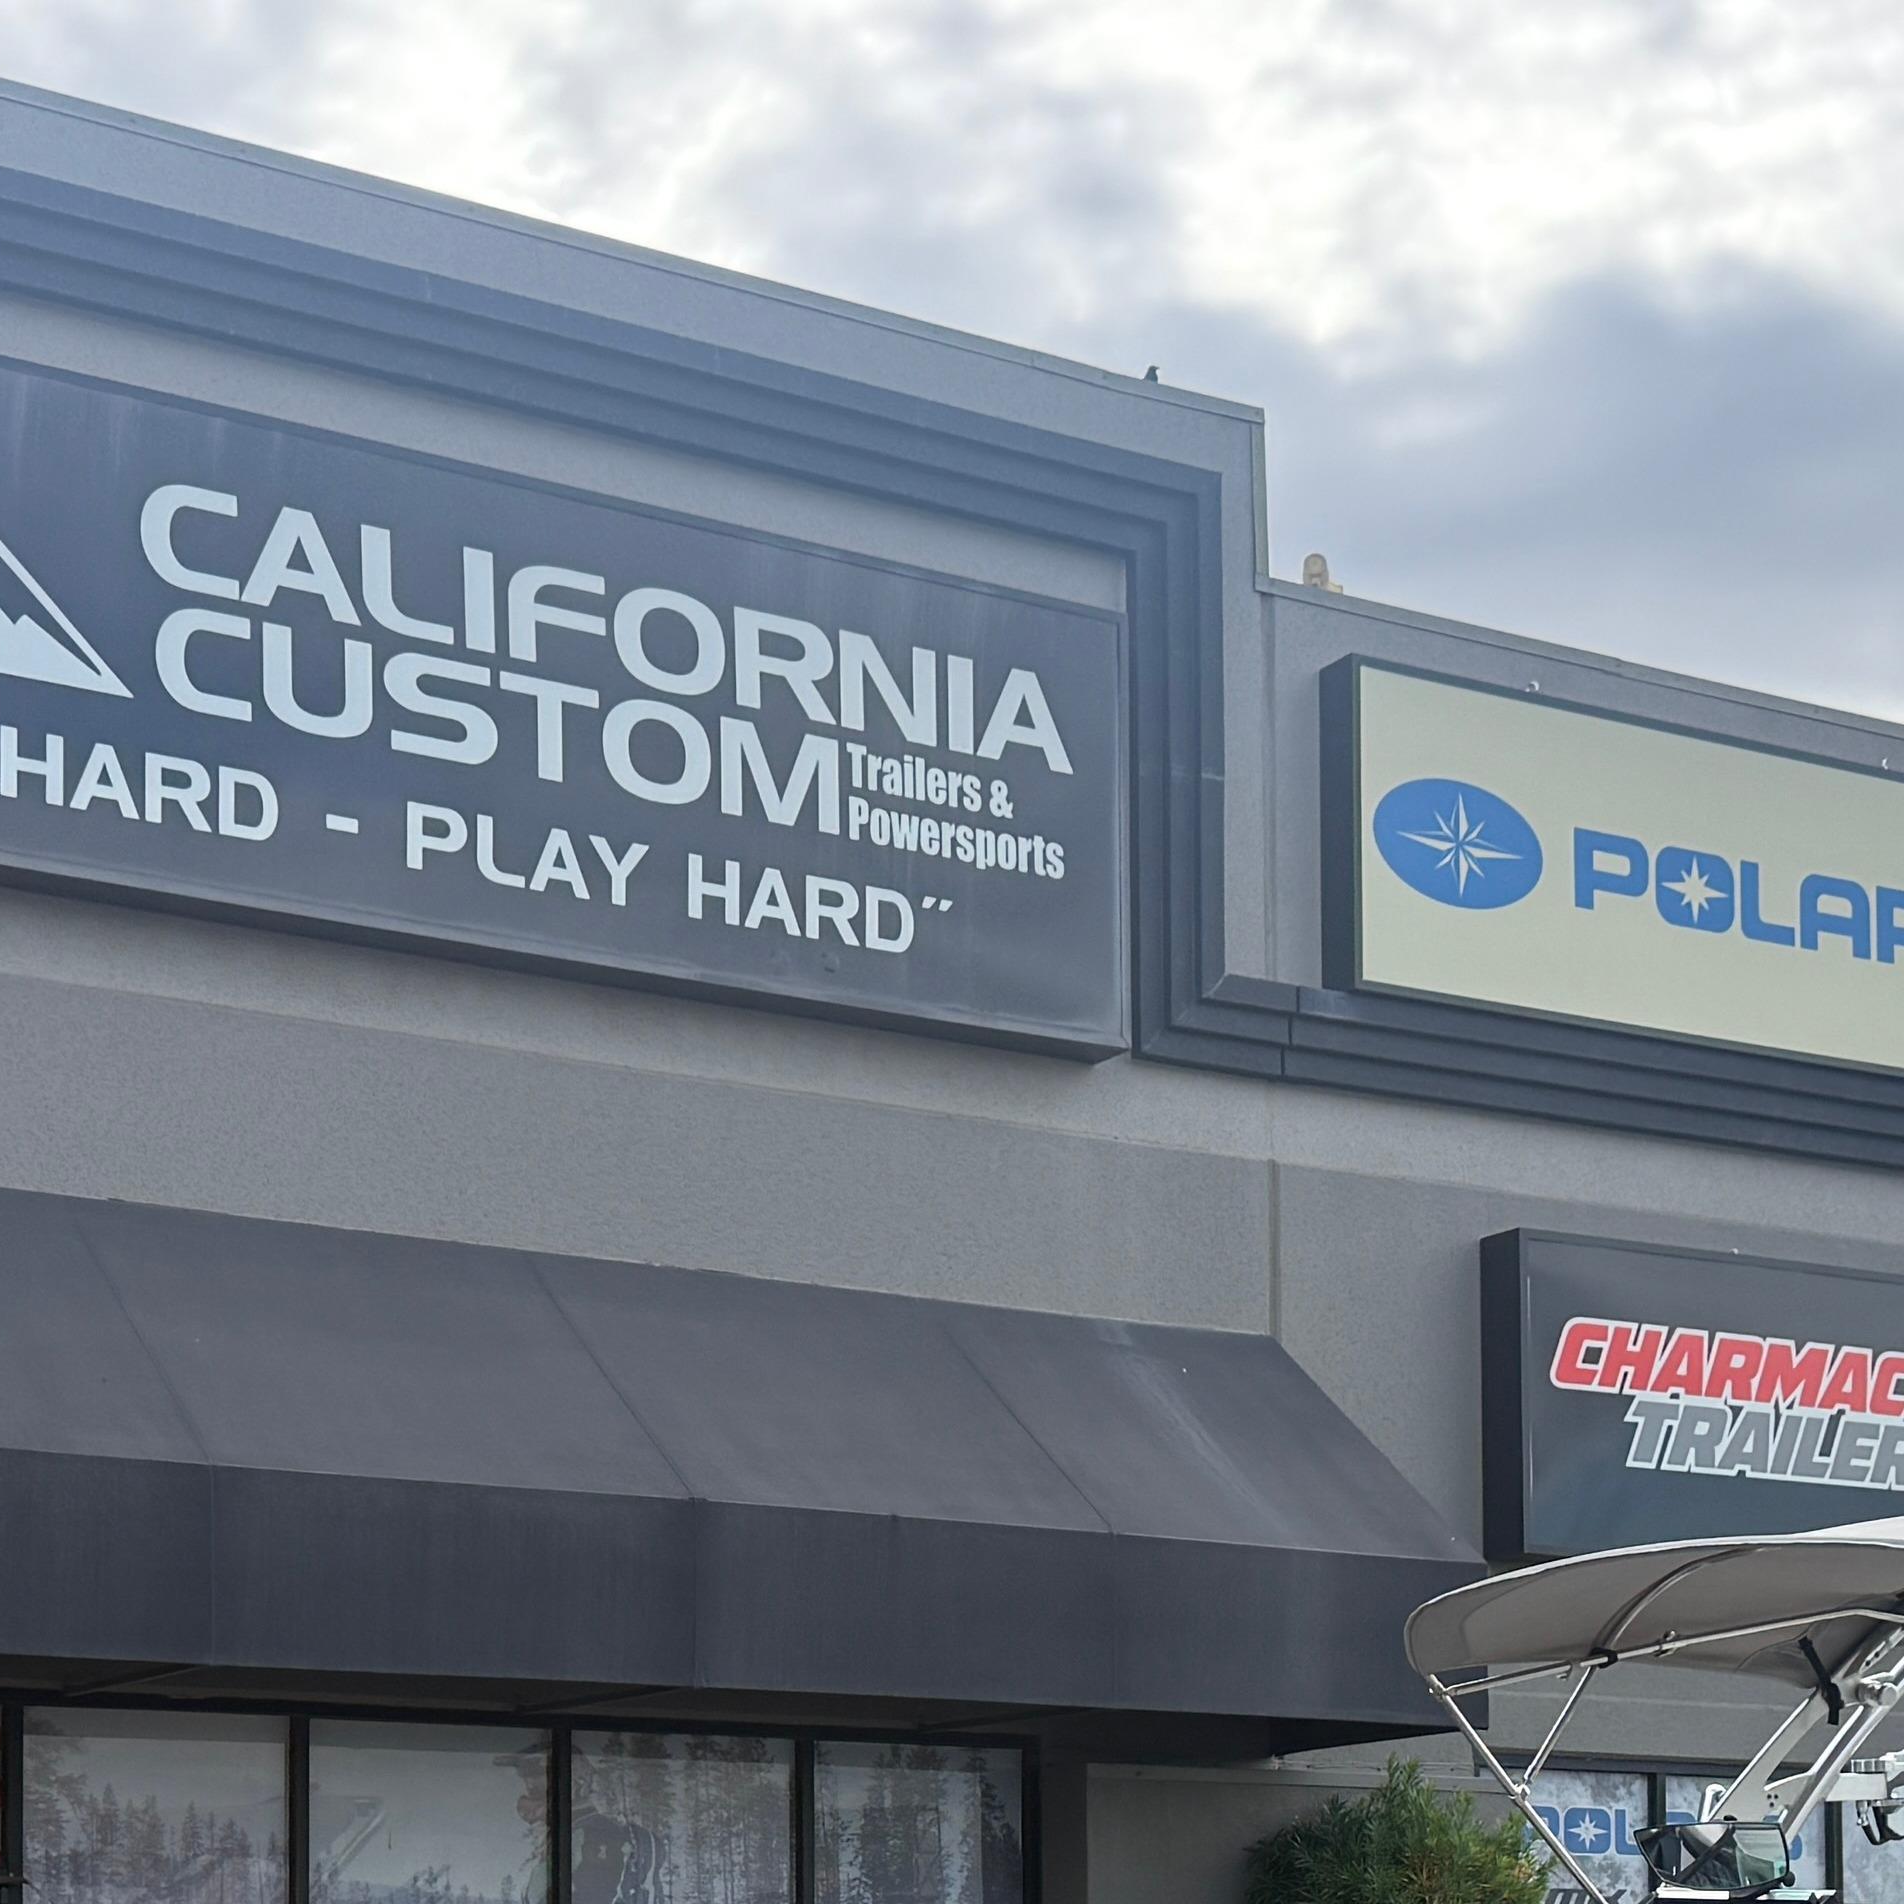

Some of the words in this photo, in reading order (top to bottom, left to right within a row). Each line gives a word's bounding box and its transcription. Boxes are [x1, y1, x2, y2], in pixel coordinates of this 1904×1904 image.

[139, 484, 1074, 775] CALIFORNIA
[155, 608, 840, 837] CUSTOM
[0, 725, 279, 842] HARD
[405, 801, 650, 908] PLAY
[687, 851, 954, 955] HARD"
[846, 740, 986, 808] Trailers
[989, 780, 1014, 821] &
[847, 795, 1066, 881] Powersports
